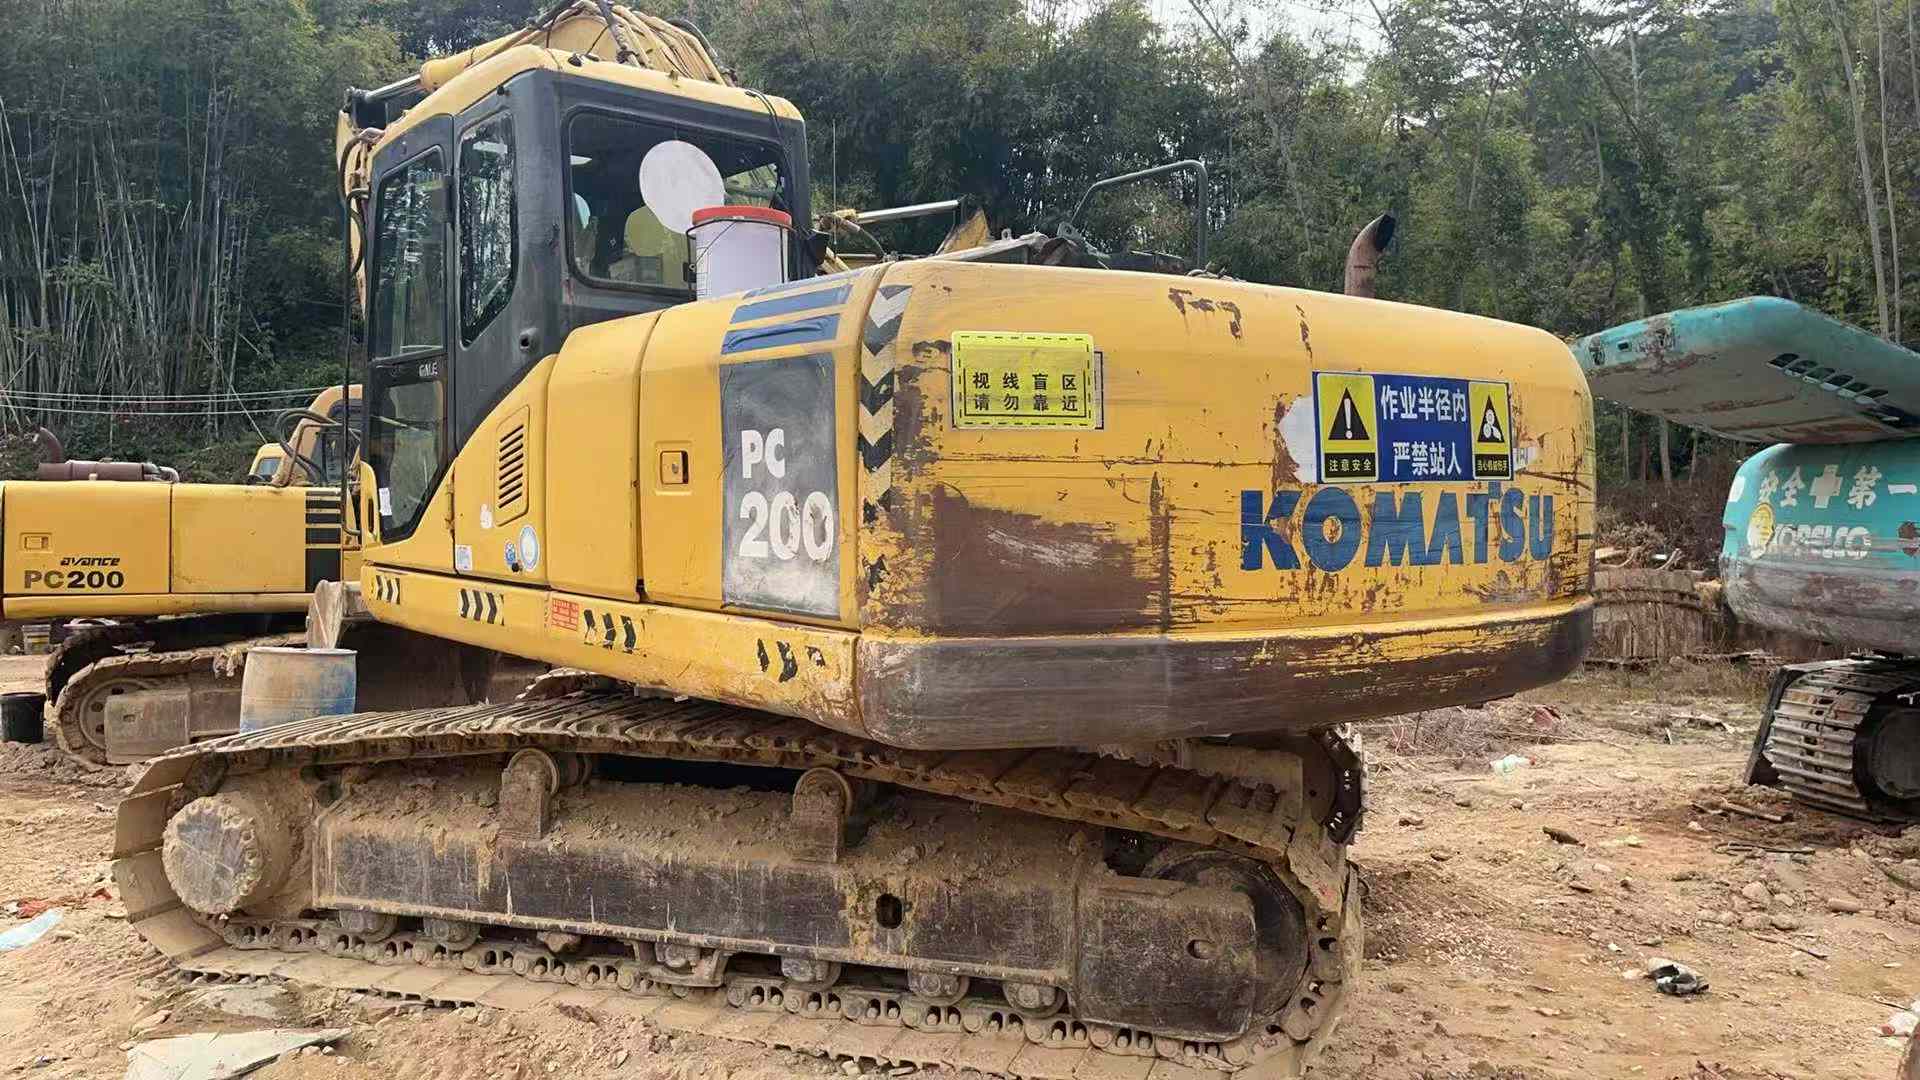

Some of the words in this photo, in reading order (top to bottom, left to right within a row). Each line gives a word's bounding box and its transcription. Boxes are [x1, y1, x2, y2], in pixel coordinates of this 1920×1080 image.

[973, 371, 1077, 390] 视线盲区
[974, 394, 1078, 412] 请勿靠近
[1381, 384, 1467, 422] 作业半径内
[741, 428, 785, 478] PC
[1328, 459, 1372, 472] 注意安全
[1392, 441, 1462, 476] 严禁站人
[739, 491, 834, 561] 200
[1240, 482, 1554, 572] KOMATSU
[60, 557, 120, 566] avance
[24, 570, 124, 588] PC200
